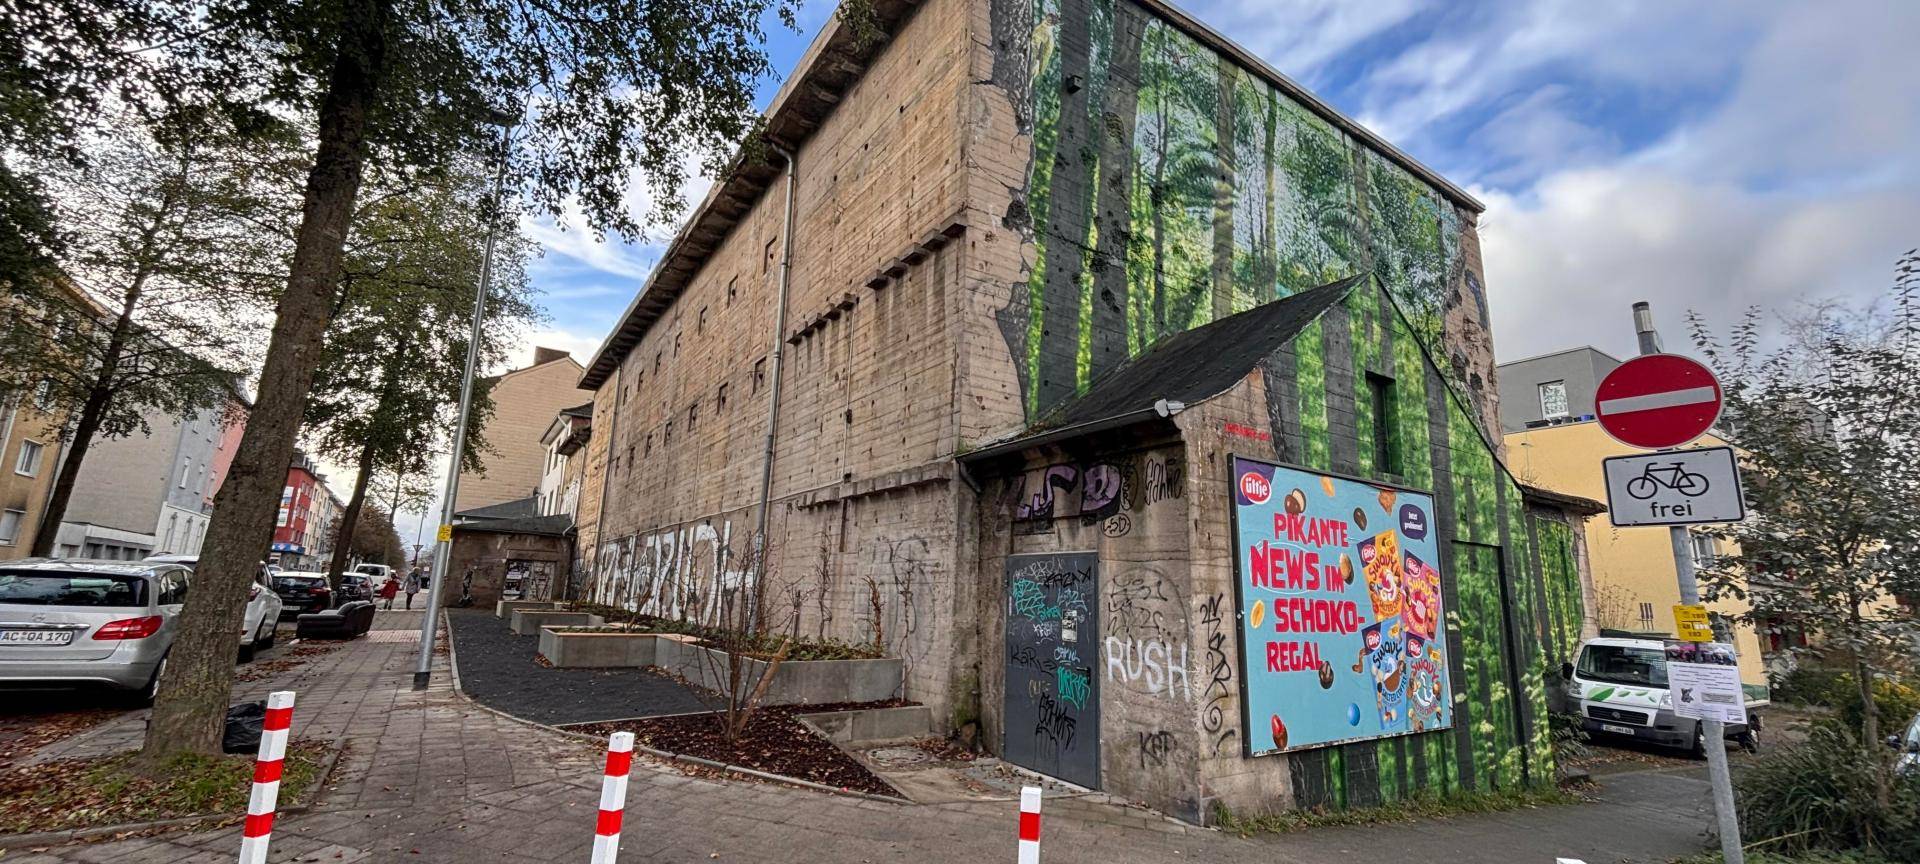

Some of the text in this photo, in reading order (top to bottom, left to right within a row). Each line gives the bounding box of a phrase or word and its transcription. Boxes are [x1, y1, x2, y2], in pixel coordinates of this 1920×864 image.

[1245, 476, 1268, 497] ültje
[1650, 500, 1693, 518] frei
[1274, 512, 1349, 548] PIKANTE
[1250, 540, 1345, 594] NEWS IM
[1274, 597, 1366, 635] SCHOKO-
[2, 632, 18, 641] AC
[46, 632, 71, 641] 170
[1105, 635, 1192, 701] RUSH
[1266, 641, 1323, 673] REGAL
